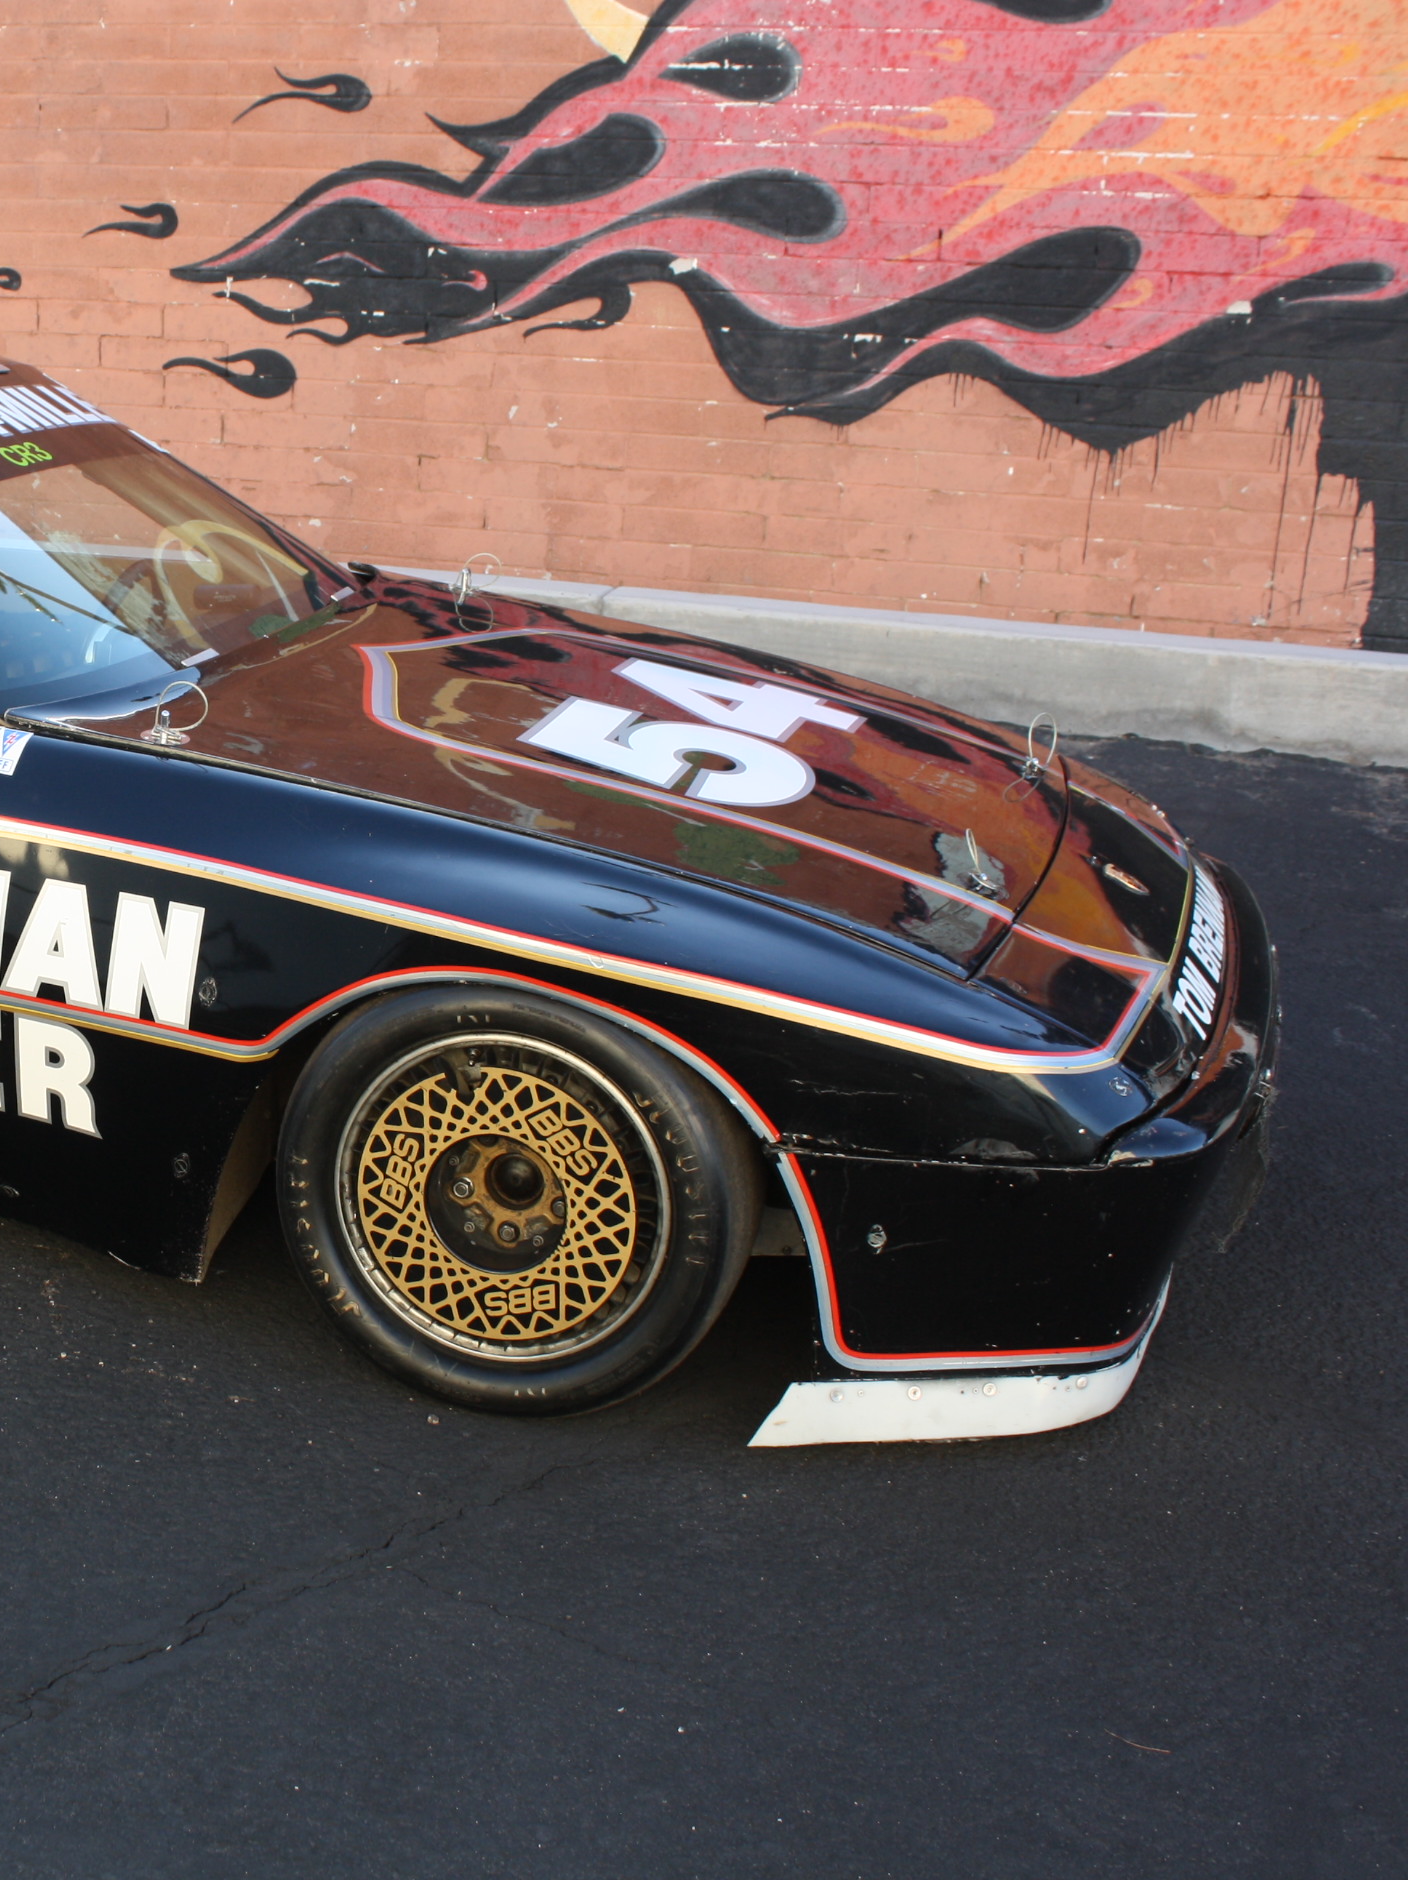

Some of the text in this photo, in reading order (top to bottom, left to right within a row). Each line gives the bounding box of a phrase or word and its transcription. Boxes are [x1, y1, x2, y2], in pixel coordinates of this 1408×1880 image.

[517, 657, 867, 807] 54
[1173, 956, 1217, 1041] TOM
[379, 1133, 420, 1210] BBS
[527, 1109, 598, 1178] BBS
[484, 1283, 556, 1317] BBS
